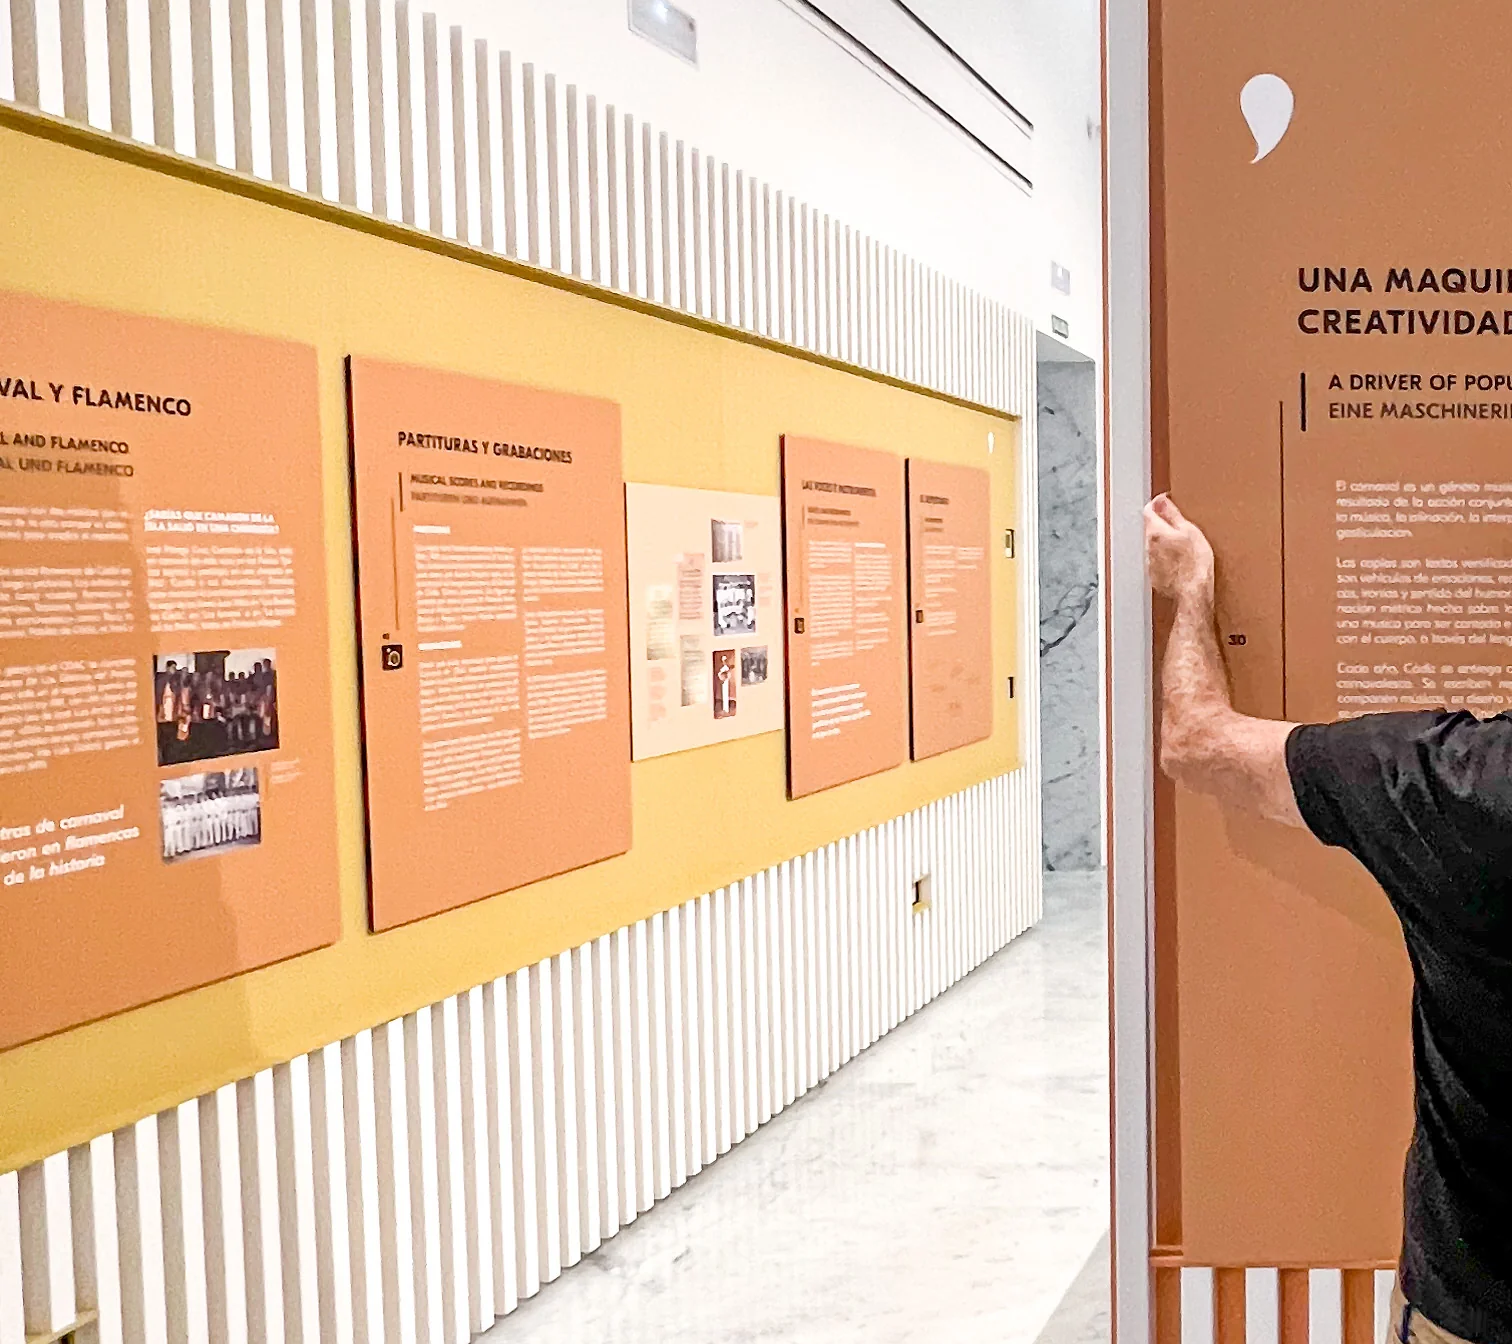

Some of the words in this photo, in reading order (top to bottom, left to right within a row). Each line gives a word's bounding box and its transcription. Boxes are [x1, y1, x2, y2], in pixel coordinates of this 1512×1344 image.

[1298, 267, 1372, 293] UNA
[1328, 375, 1343, 391] A
[1350, 374, 1423, 391] DRIVER
[1429, 375, 1458, 391] OF
[49, 382, 64, 403] Y
[72, 385, 192, 417] FLAMENCO
[1328, 403, 1374, 419] EINE
[13, 433, 46, 448] AND
[50, 436, 129, 454] FLAMENCO
[398, 431, 478, 454] PARTITURAS
[482, 441, 490, 455] Y
[493, 442, 573, 464] GRABACIONES
[18, 458, 52, 472] UND
[56, 459, 134, 477] FLAMENCO
[35, 817, 56, 834] de
[60, 804, 124, 830] carnaval
[42, 839, 61, 856] en
[4, 870, 25, 886] de
[29, 865, 45, 881] la
[49, 853, 106, 877] historia
